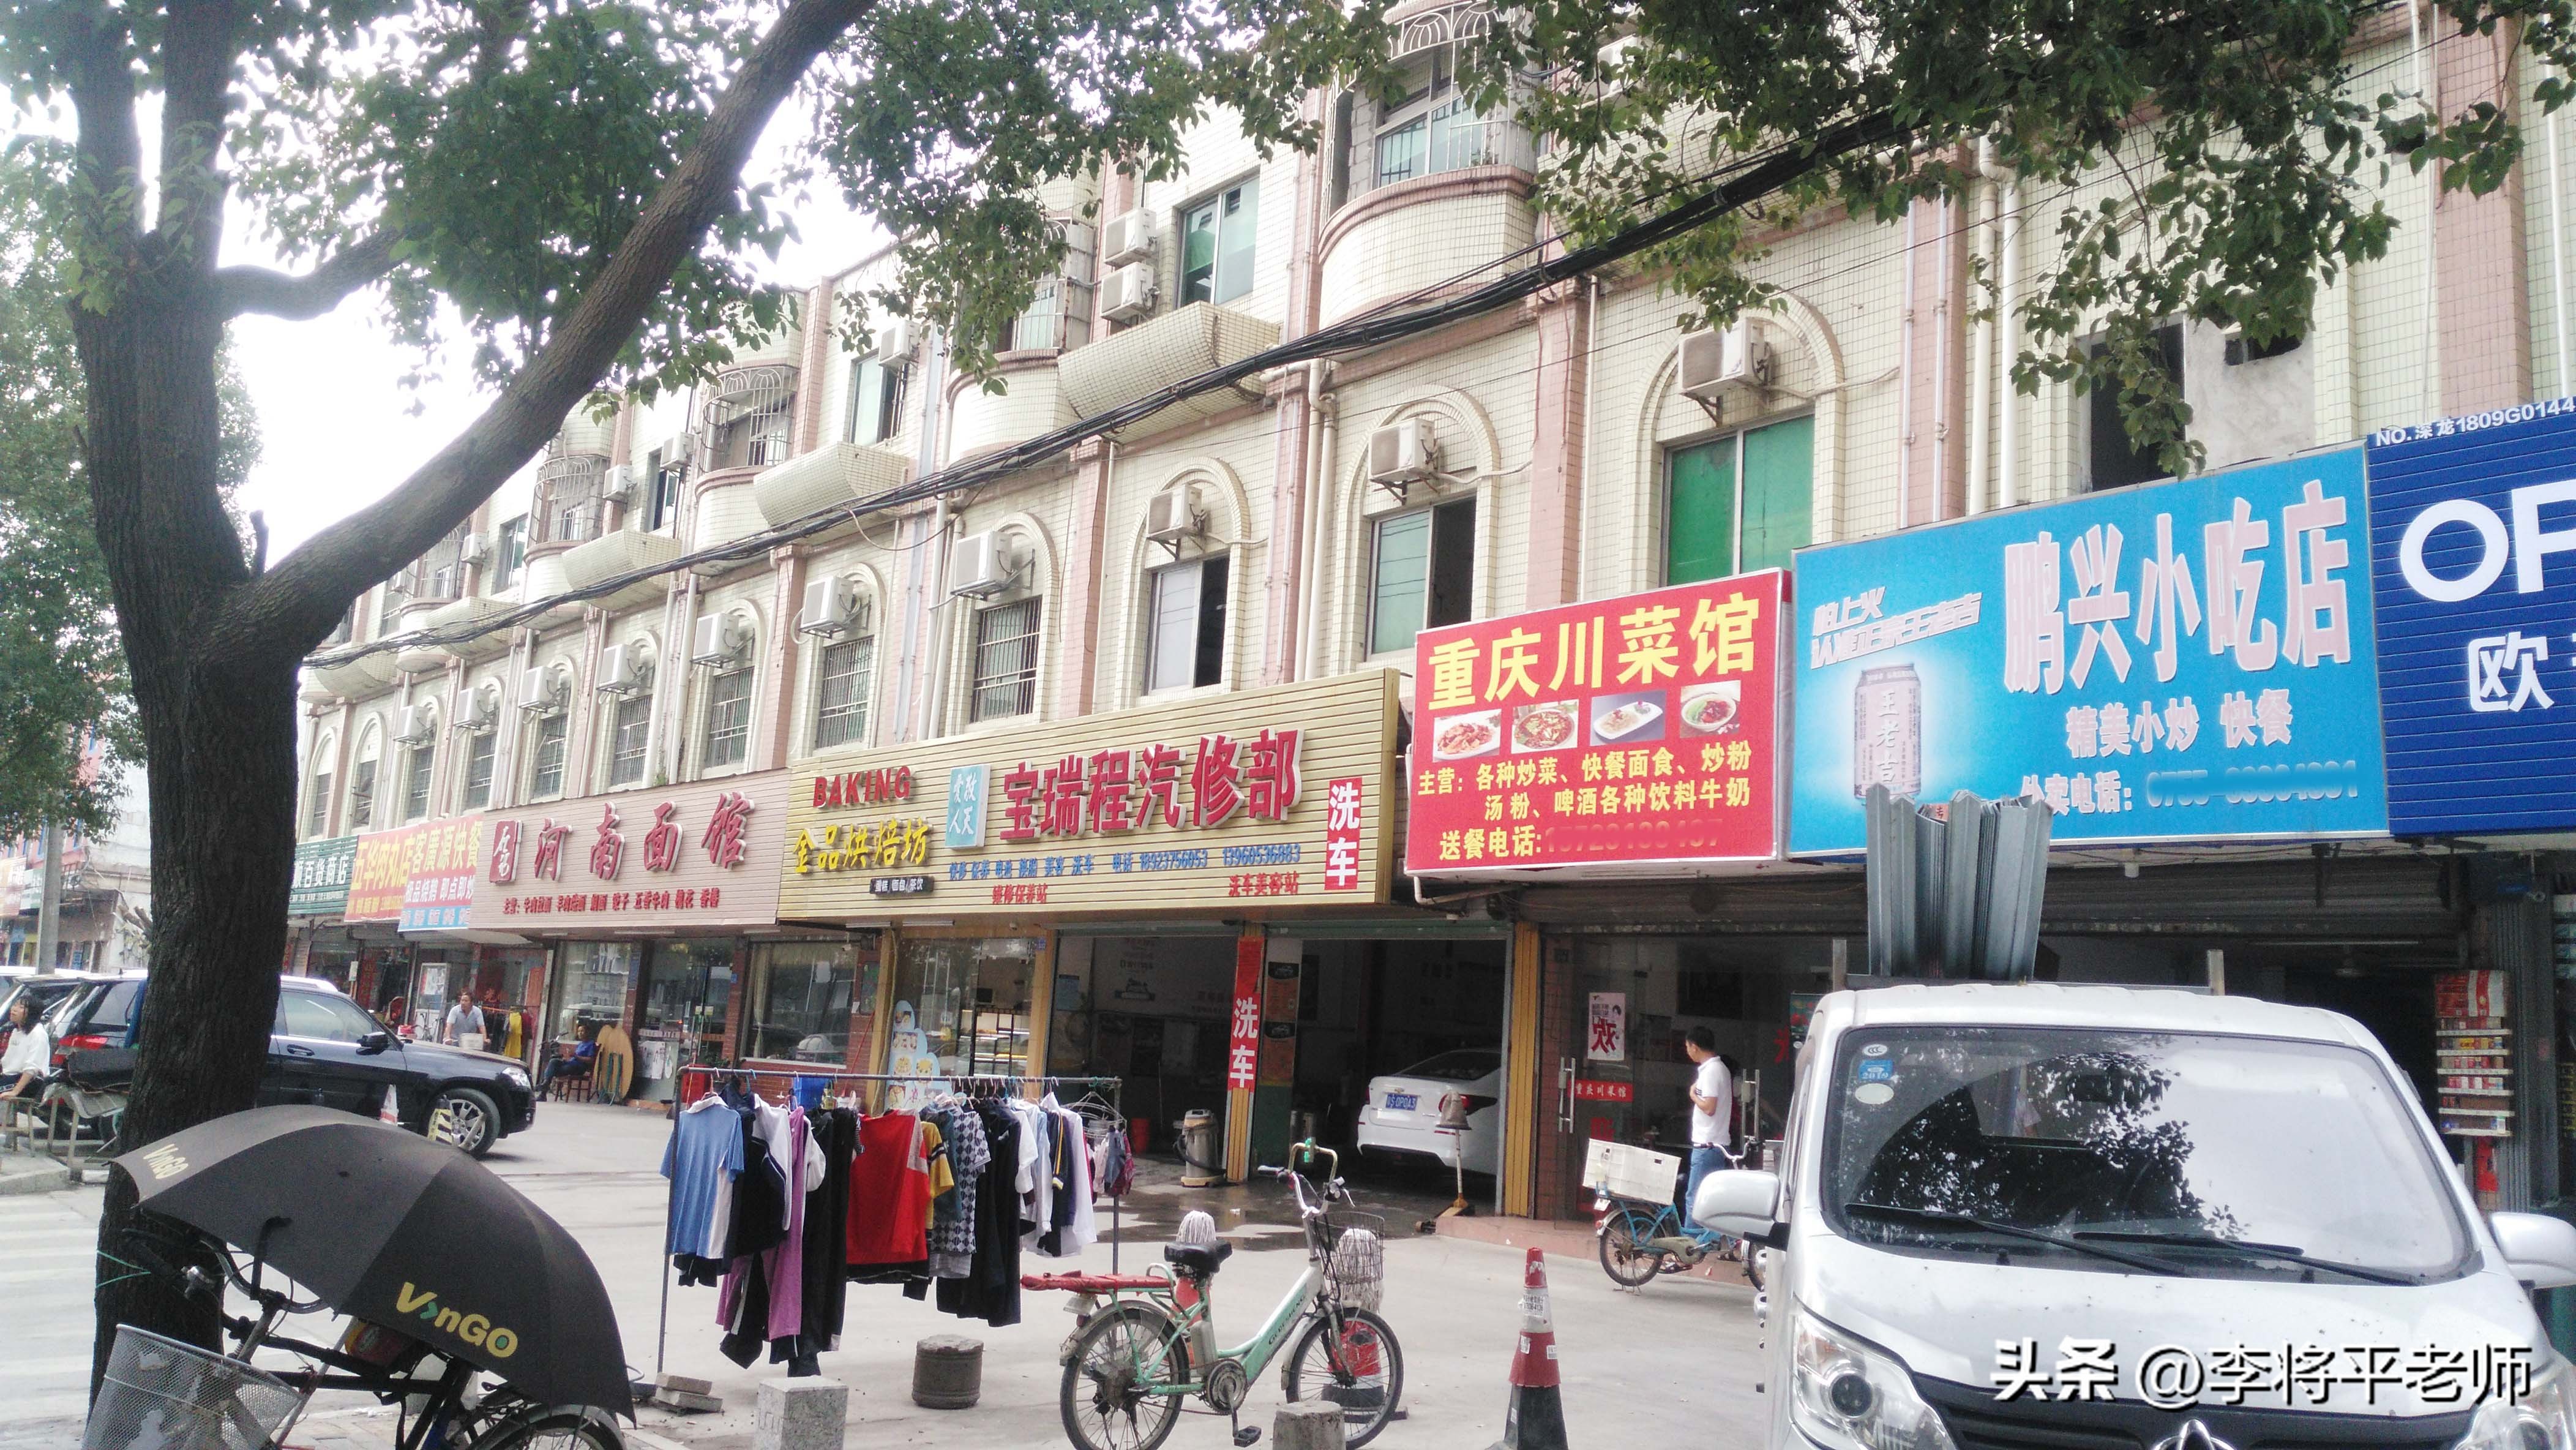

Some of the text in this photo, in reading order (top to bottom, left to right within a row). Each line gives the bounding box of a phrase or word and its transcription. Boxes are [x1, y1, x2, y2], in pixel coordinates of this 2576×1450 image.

[1812, 586, 1886, 637] 怕上火
[2004, 479, 2351, 694] 鹏兴小吃店
[1429, 592, 1759, 710] 重庆川菜馆
[1811, 592, 1983, 669] 认准正宗王老吉
[2468, 631, 2576, 713] 欧
[1876, 689, 1900, 783] 王老吉
[2066, 689, 2293, 758] 精美小炒 快餐
[813, 766, 914, 808] BAKING
[1000, 727, 1305, 840] 宝瑞程汽修部
[534, 791, 755, 881] 河南面馆
[793, 816, 929, 873] 金品烘焙坊
[1072, 854, 1095, 876] 洗车
[1112, 852, 1133, 872] 电话
[1326, 781, 1360, 887] 洗车
[1229, 870, 1299, 897] 洗车美容站
[1230, 997, 1258, 1088] 洗车
